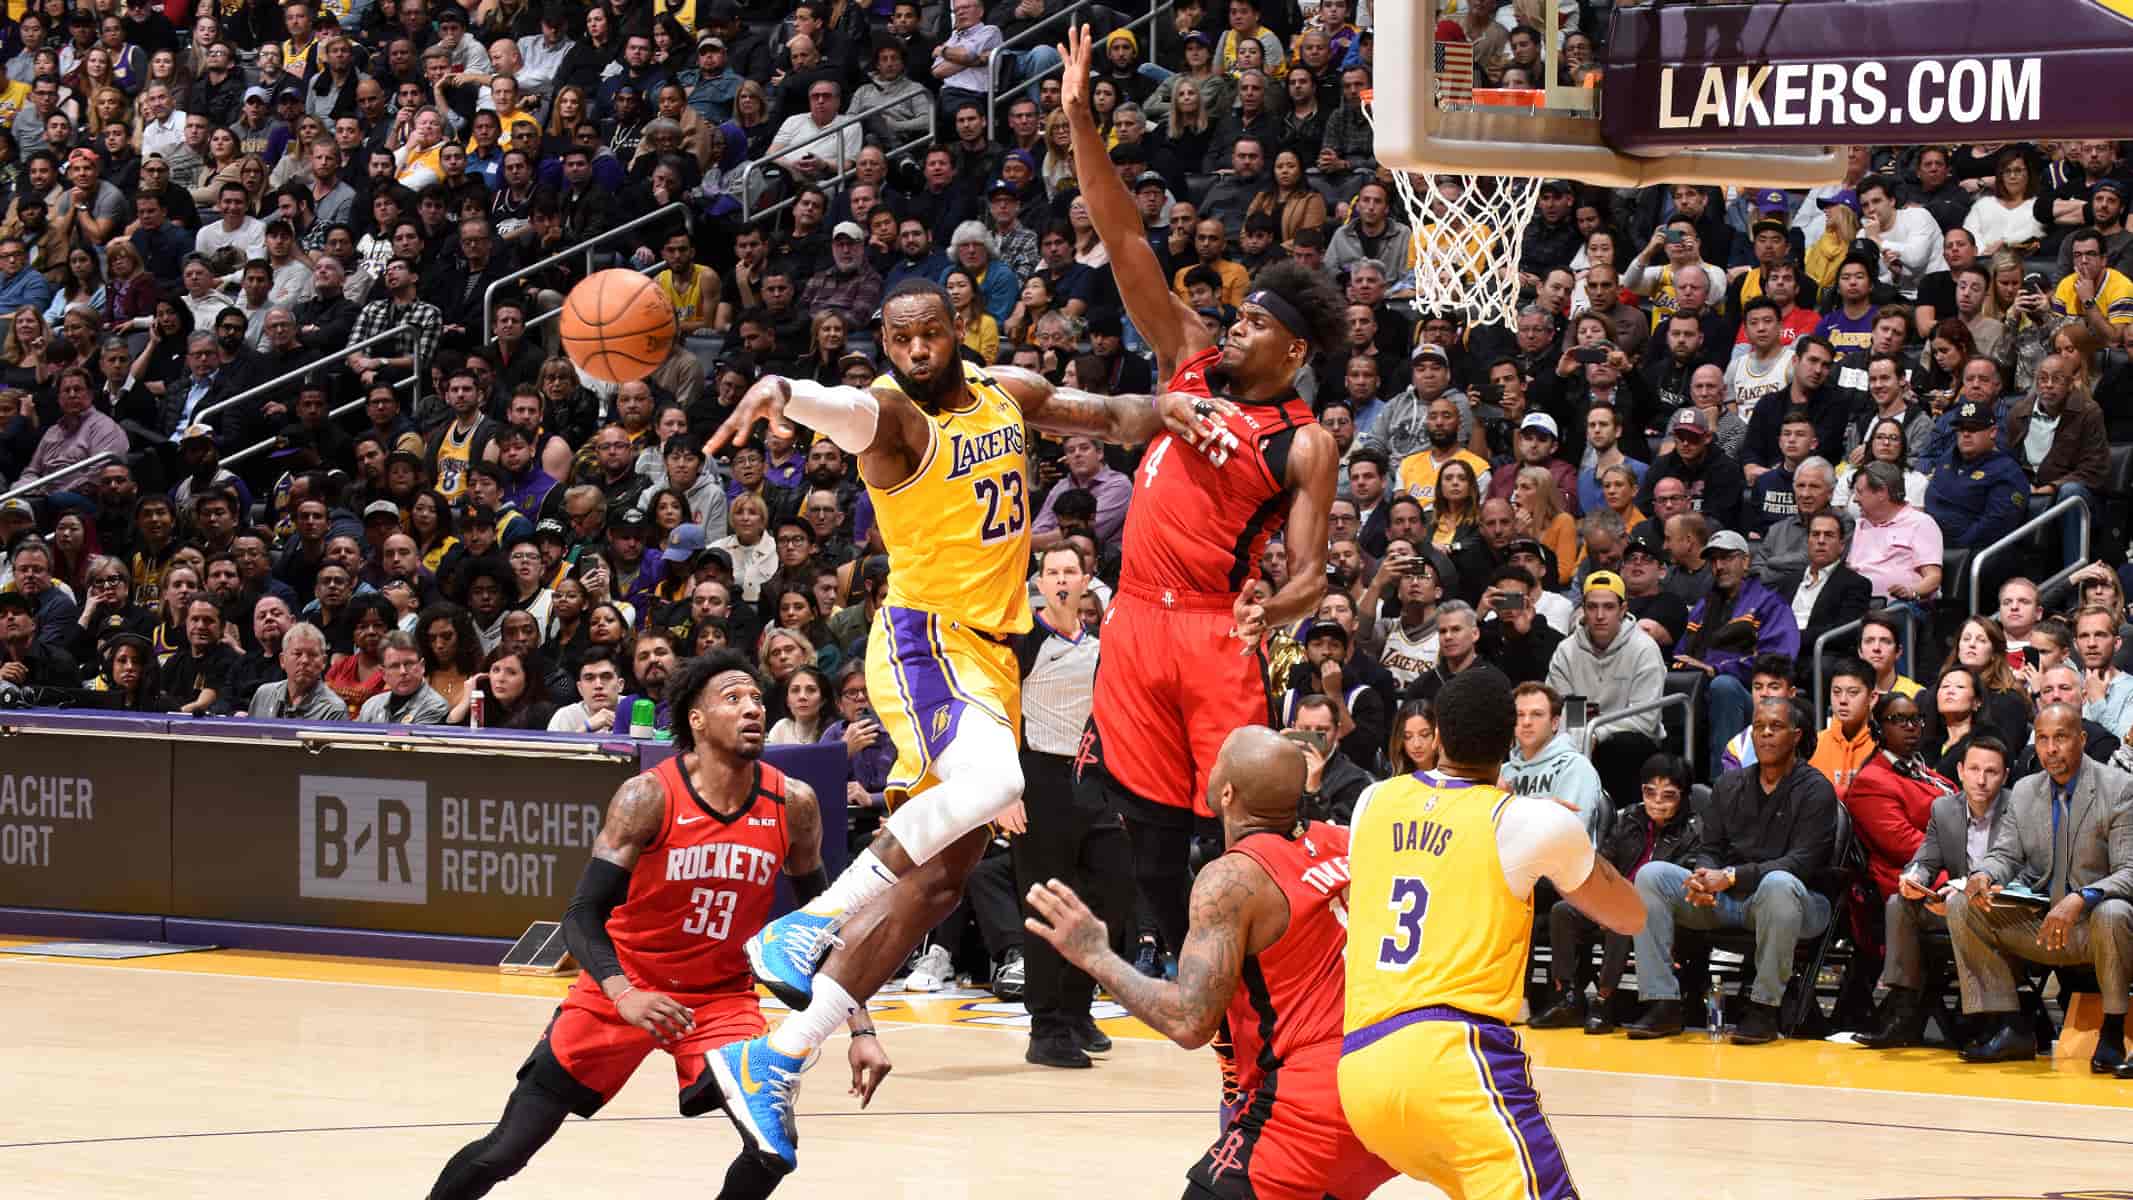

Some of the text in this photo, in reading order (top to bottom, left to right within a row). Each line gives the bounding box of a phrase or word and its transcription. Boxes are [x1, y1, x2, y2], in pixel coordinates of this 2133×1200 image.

[1659, 58, 2042, 128] LAKERS.COM
[944, 424, 1024, 480] LAKERS
[1145, 434, 1173, 488] 4
[973, 470, 1025, 545] 23
[442, 797, 600, 848] BLEACHER
[1393, 820, 1453, 857] DAVIS
[442, 849, 557, 897] REPORT
[665, 842, 777, 886] ROCKETS
[682, 887, 738, 940] 33
[1376, 876, 1431, 972] 3
